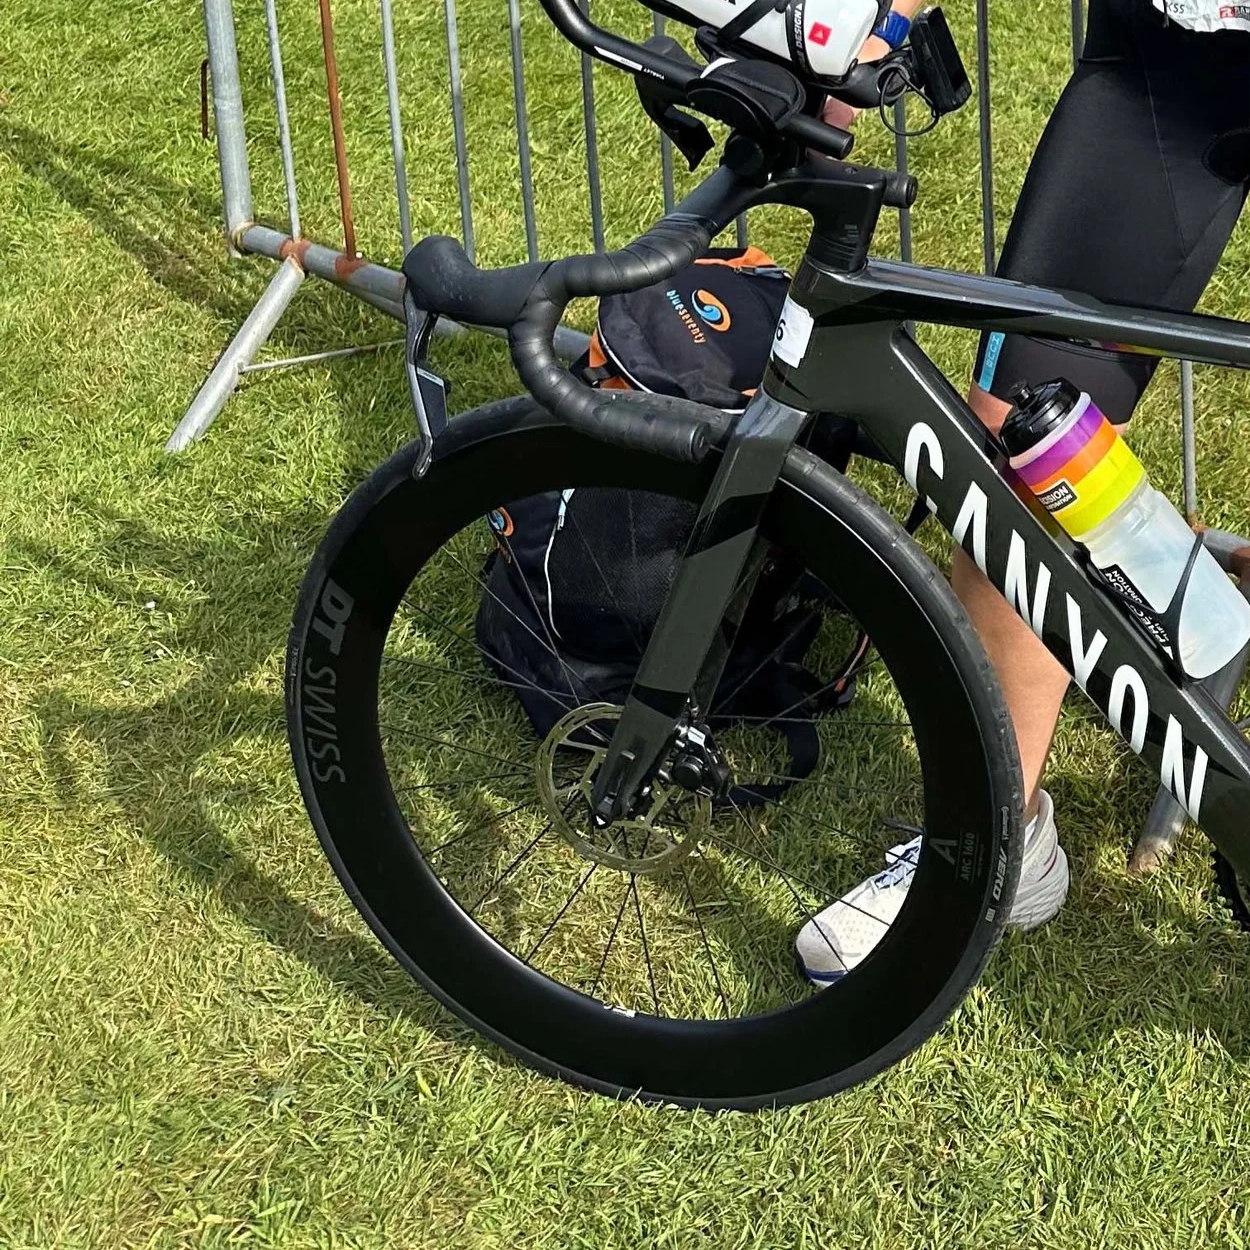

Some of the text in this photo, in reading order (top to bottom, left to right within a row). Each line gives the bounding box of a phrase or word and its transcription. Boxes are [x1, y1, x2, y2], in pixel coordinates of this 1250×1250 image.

[666, 288, 707, 344] blueseventy
[904, 421, 1209, 825] CANYON
[303, 578, 354, 783] DT SWISS
[960, 832, 976, 881] ARC 1600
[992, 846, 1008, 901] AERO
